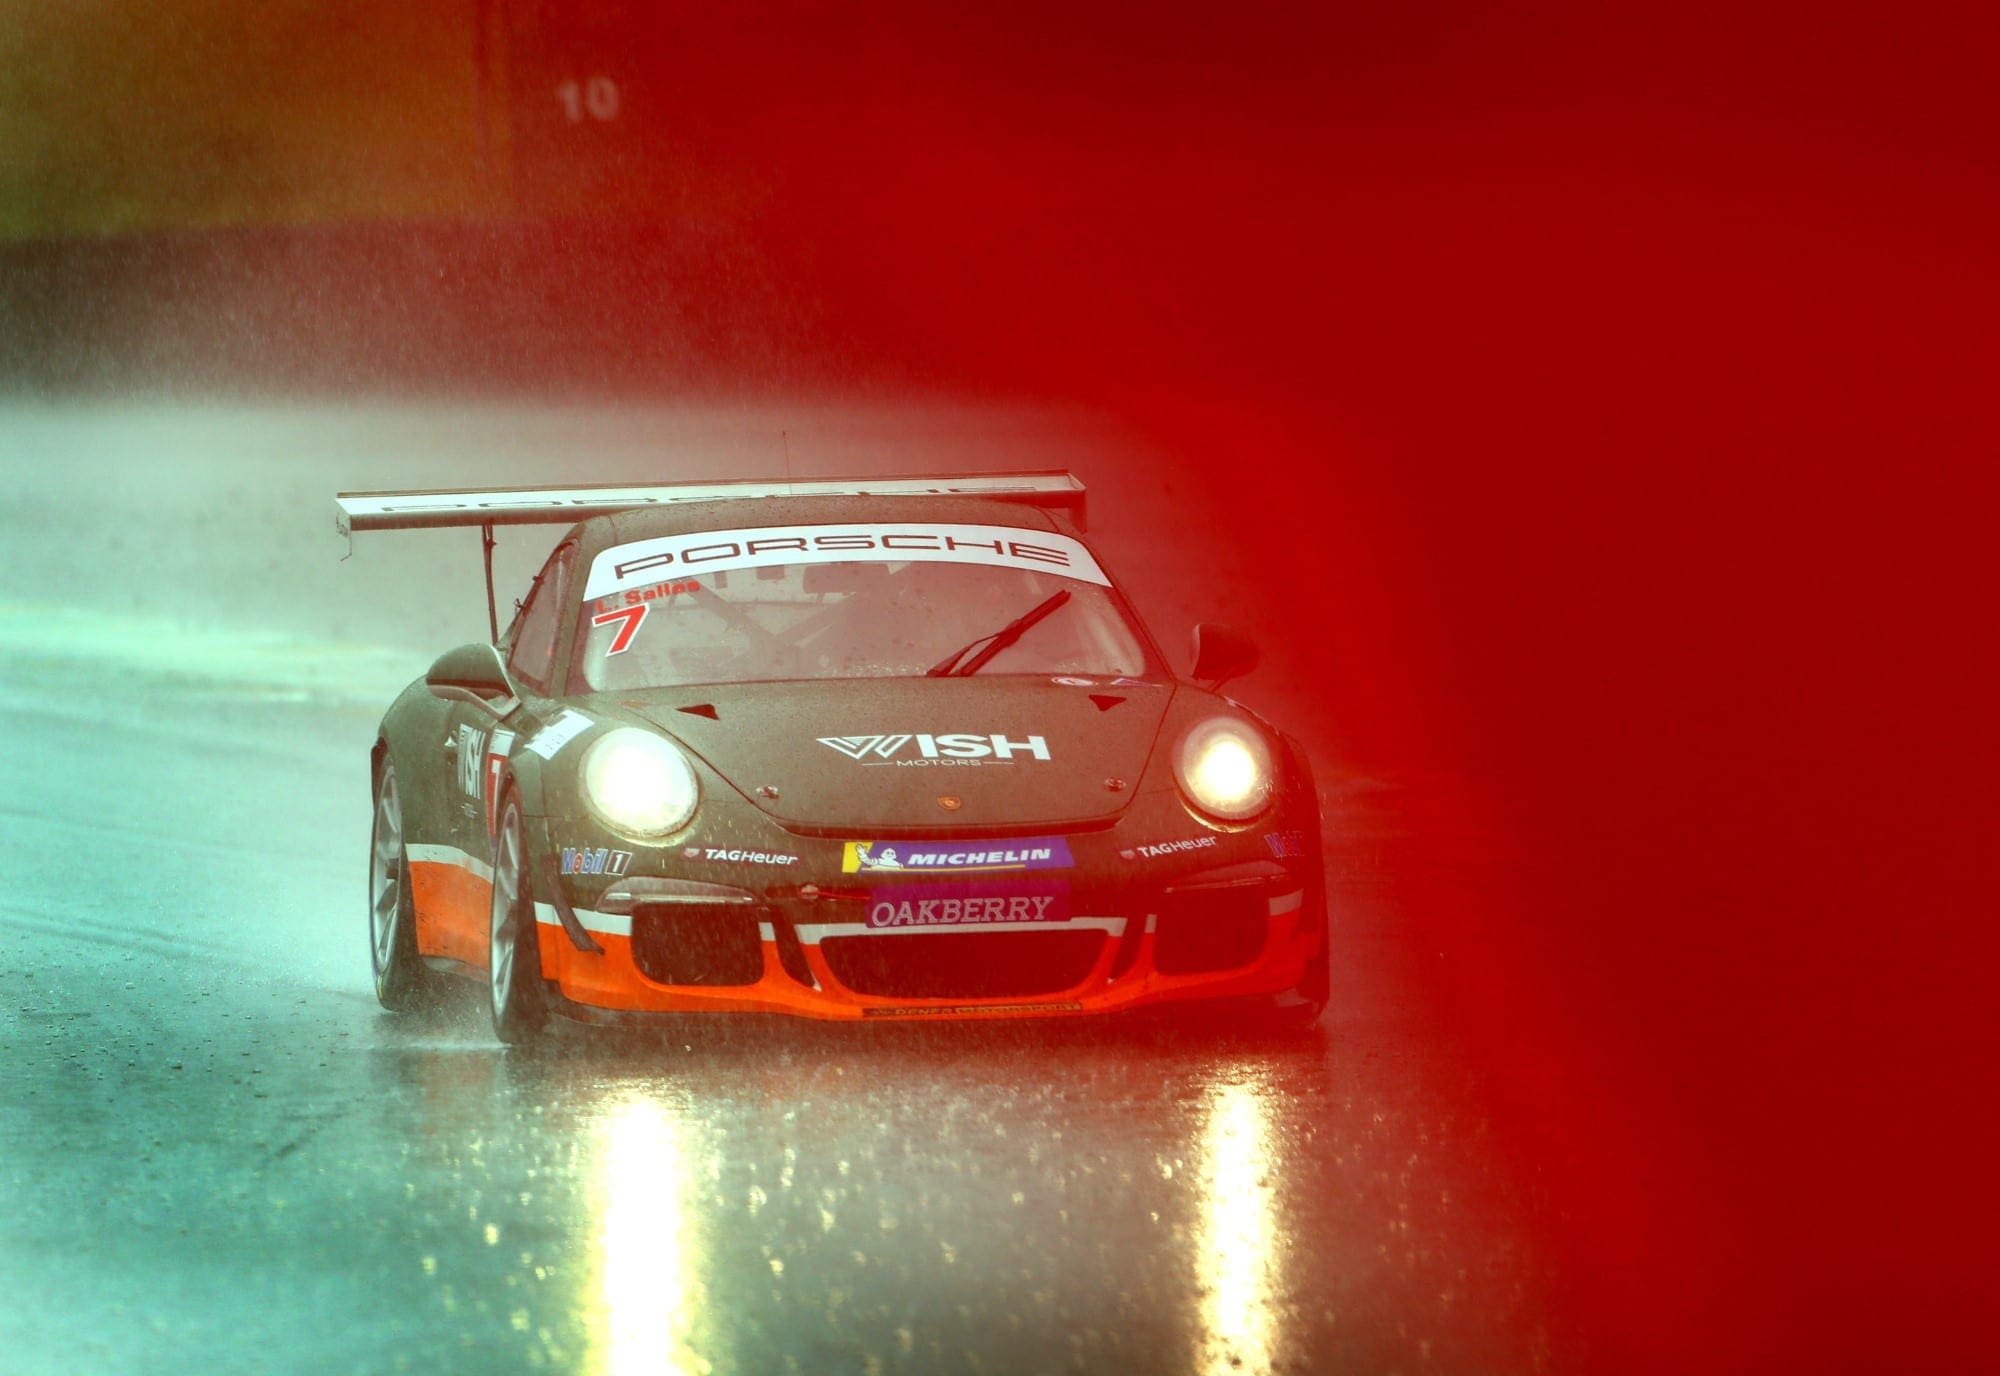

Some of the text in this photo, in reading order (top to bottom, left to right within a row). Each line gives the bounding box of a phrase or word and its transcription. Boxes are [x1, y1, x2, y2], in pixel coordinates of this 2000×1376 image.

[555, 78, 619, 121] 10
[614, 534, 1071, 580] PORSCHE
[592, 603, 650, 657] 7
[816, 734, 1051, 760] WISH
[896, 759, 982, 767] MOTORS
[561, 848, 608, 875] Mobil
[907, 848, 1051, 865] MICHELIN
[871, 897, 1055, 927] OAKBERRY
